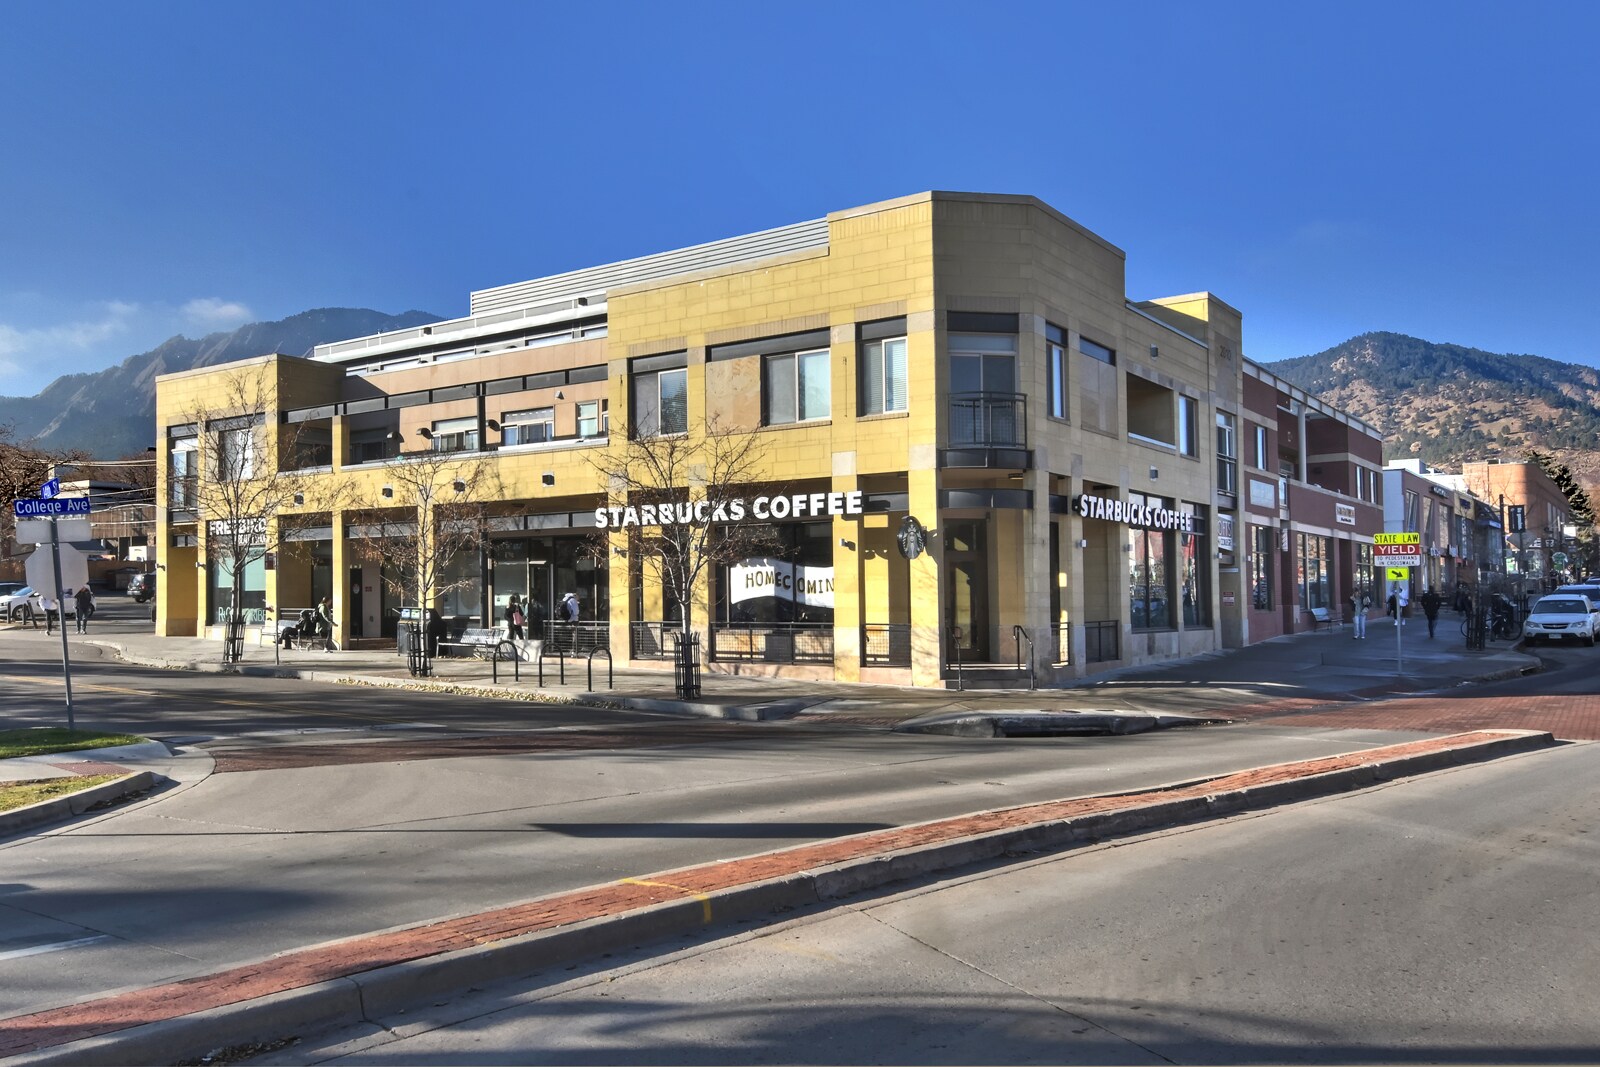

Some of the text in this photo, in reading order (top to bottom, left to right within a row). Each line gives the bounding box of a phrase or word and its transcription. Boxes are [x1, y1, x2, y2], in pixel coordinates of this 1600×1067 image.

[16, 499, 88, 515] College Ave
[594, 491, 862, 528] STARBUCKS COFFEE
[1080, 494, 1191, 531] STARBUCKS COFFEE
[1374, 534, 1419, 543] STATE LAW
[1378, 545, 1416, 554] YIELD
[745, 571, 835, 594] HOMECOMIN
